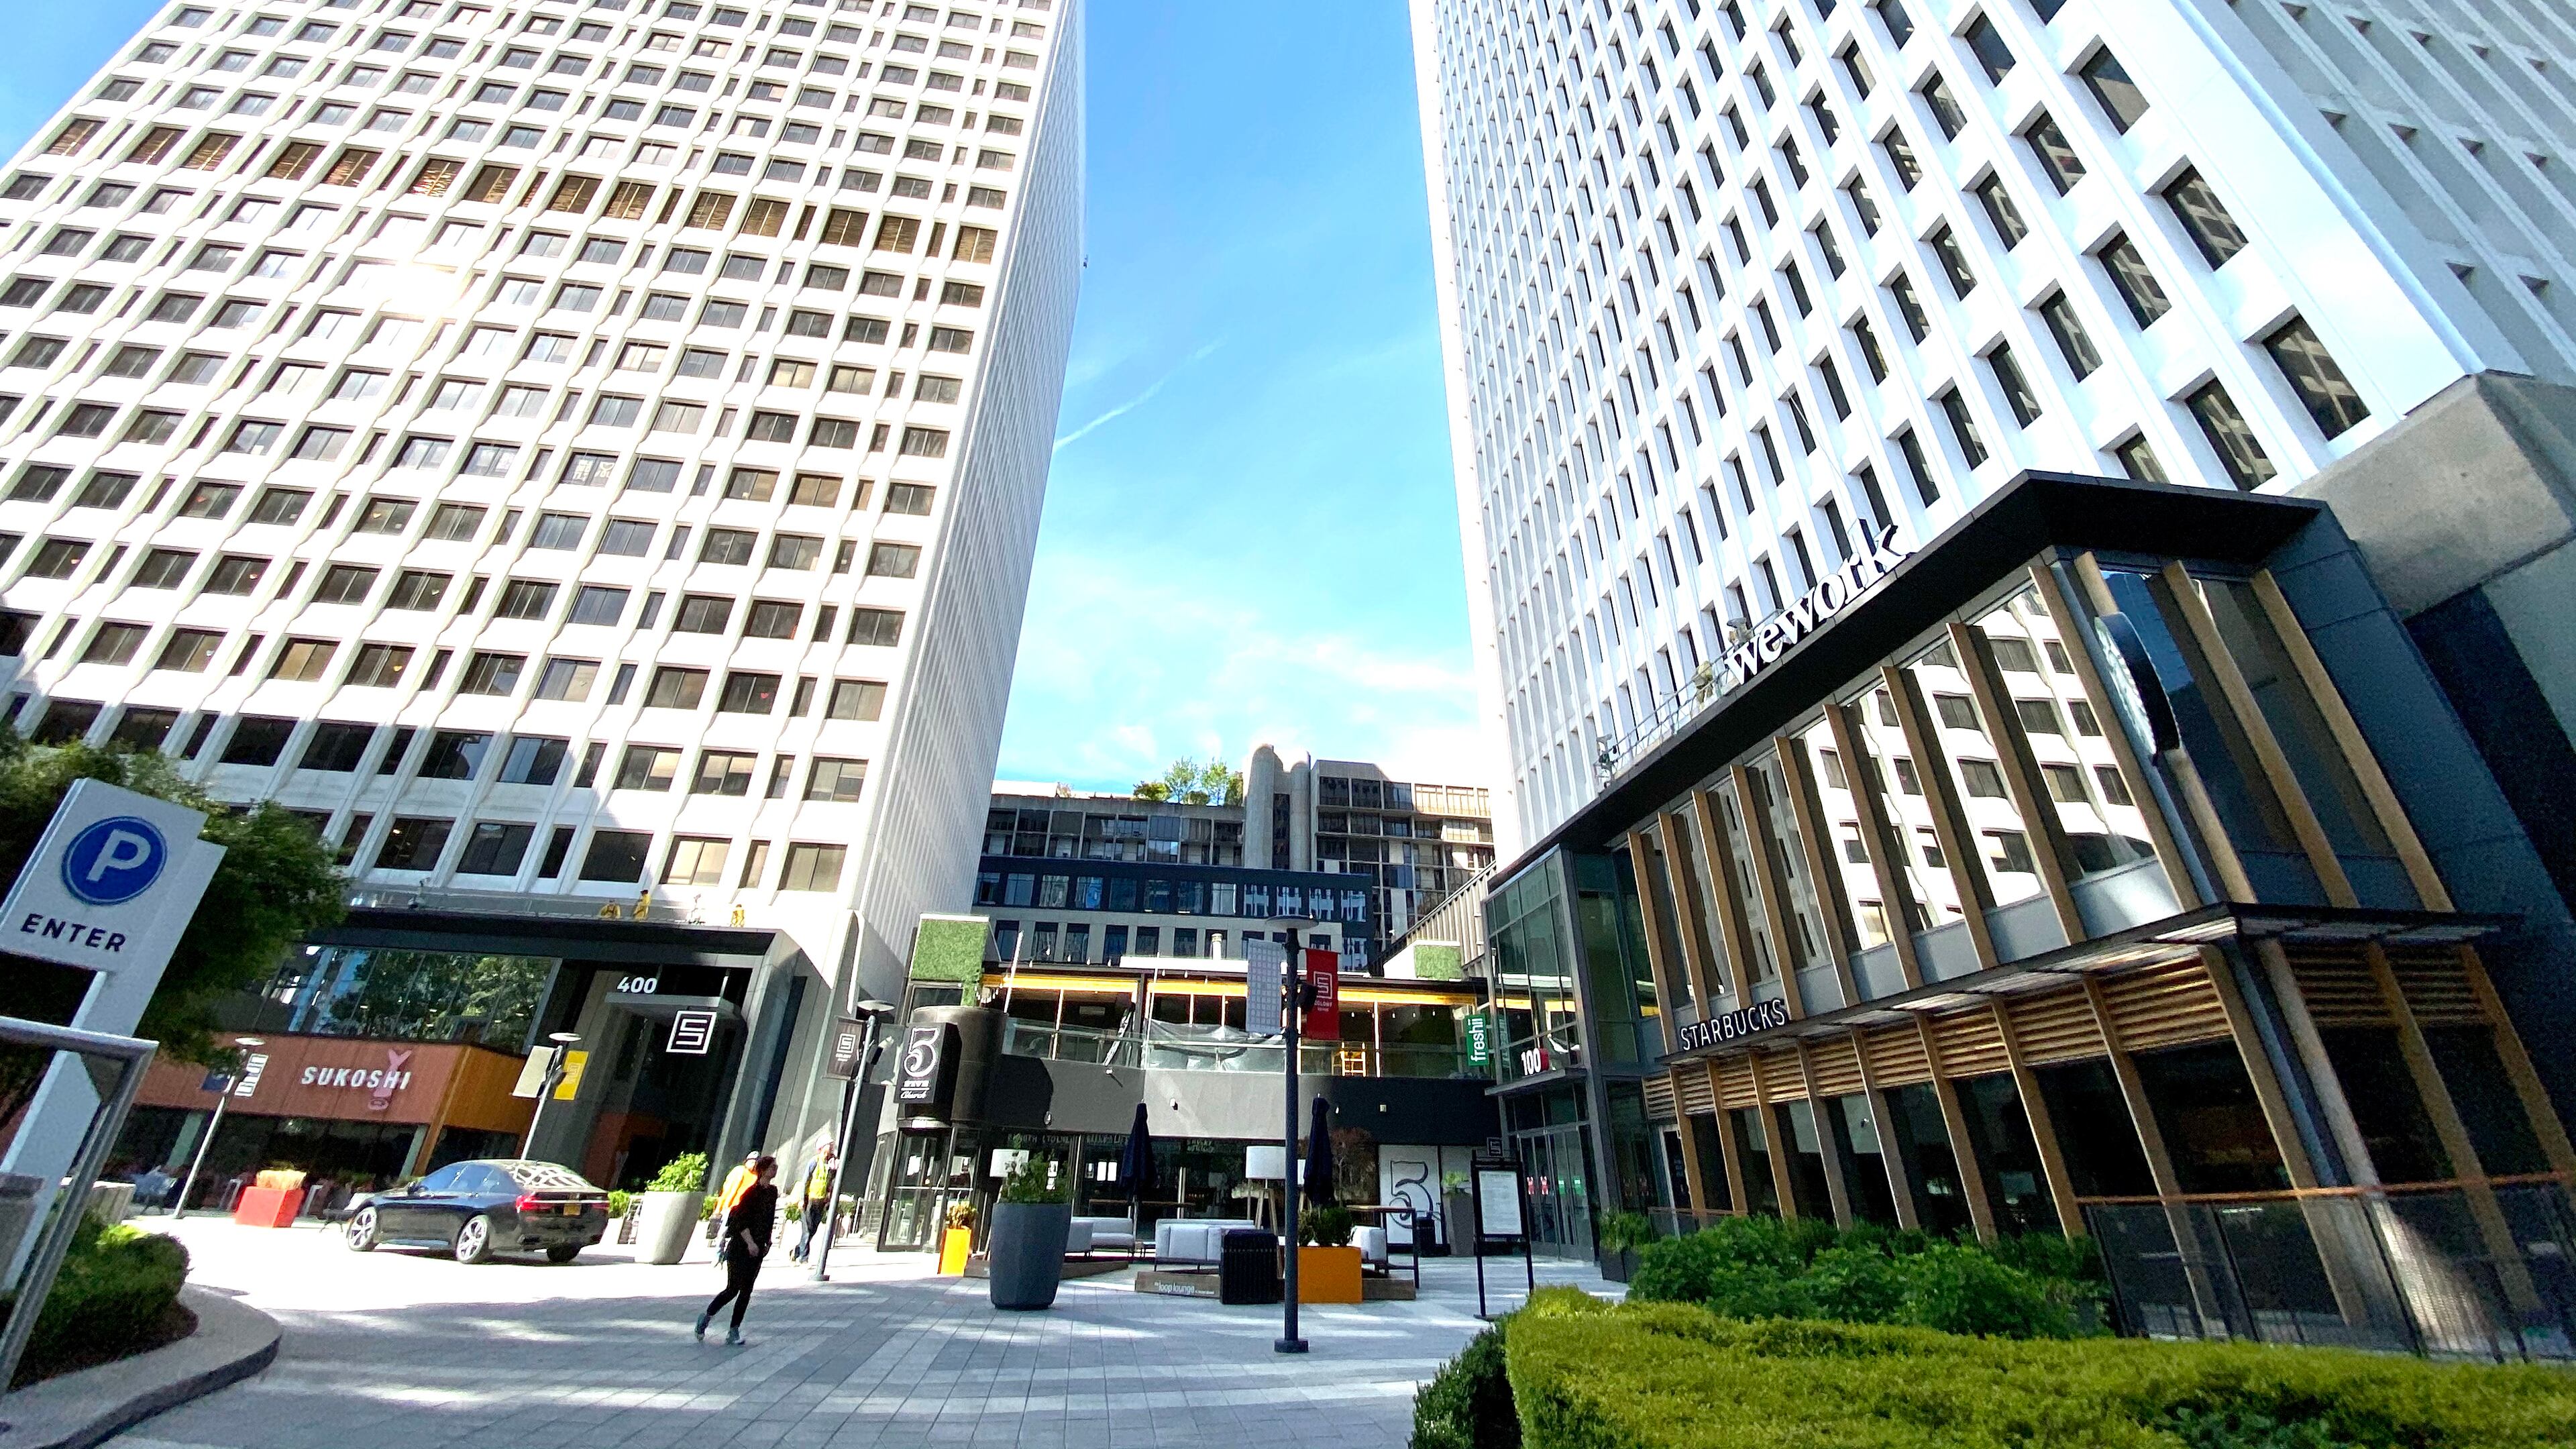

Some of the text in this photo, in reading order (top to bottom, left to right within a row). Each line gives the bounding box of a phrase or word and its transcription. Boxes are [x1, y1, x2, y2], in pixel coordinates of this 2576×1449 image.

[1724, 518, 1908, 685] wework
[86, 828, 152, 882] P
[20, 913, 127, 953] ENTER
[616, 976, 658, 994] 400
[1468, 1018, 1486, 1062] freshii
[1680, 999, 1785, 1051] STARBUCKS
[904, 1027, 939, 1077] 5
[1521, 1048, 1542, 1076] 100
[301, 1066, 412, 1090] SUKOSHI
[1159, 1280, 1173, 1293] loop
[1173, 1282, 1195, 1295] lounge
